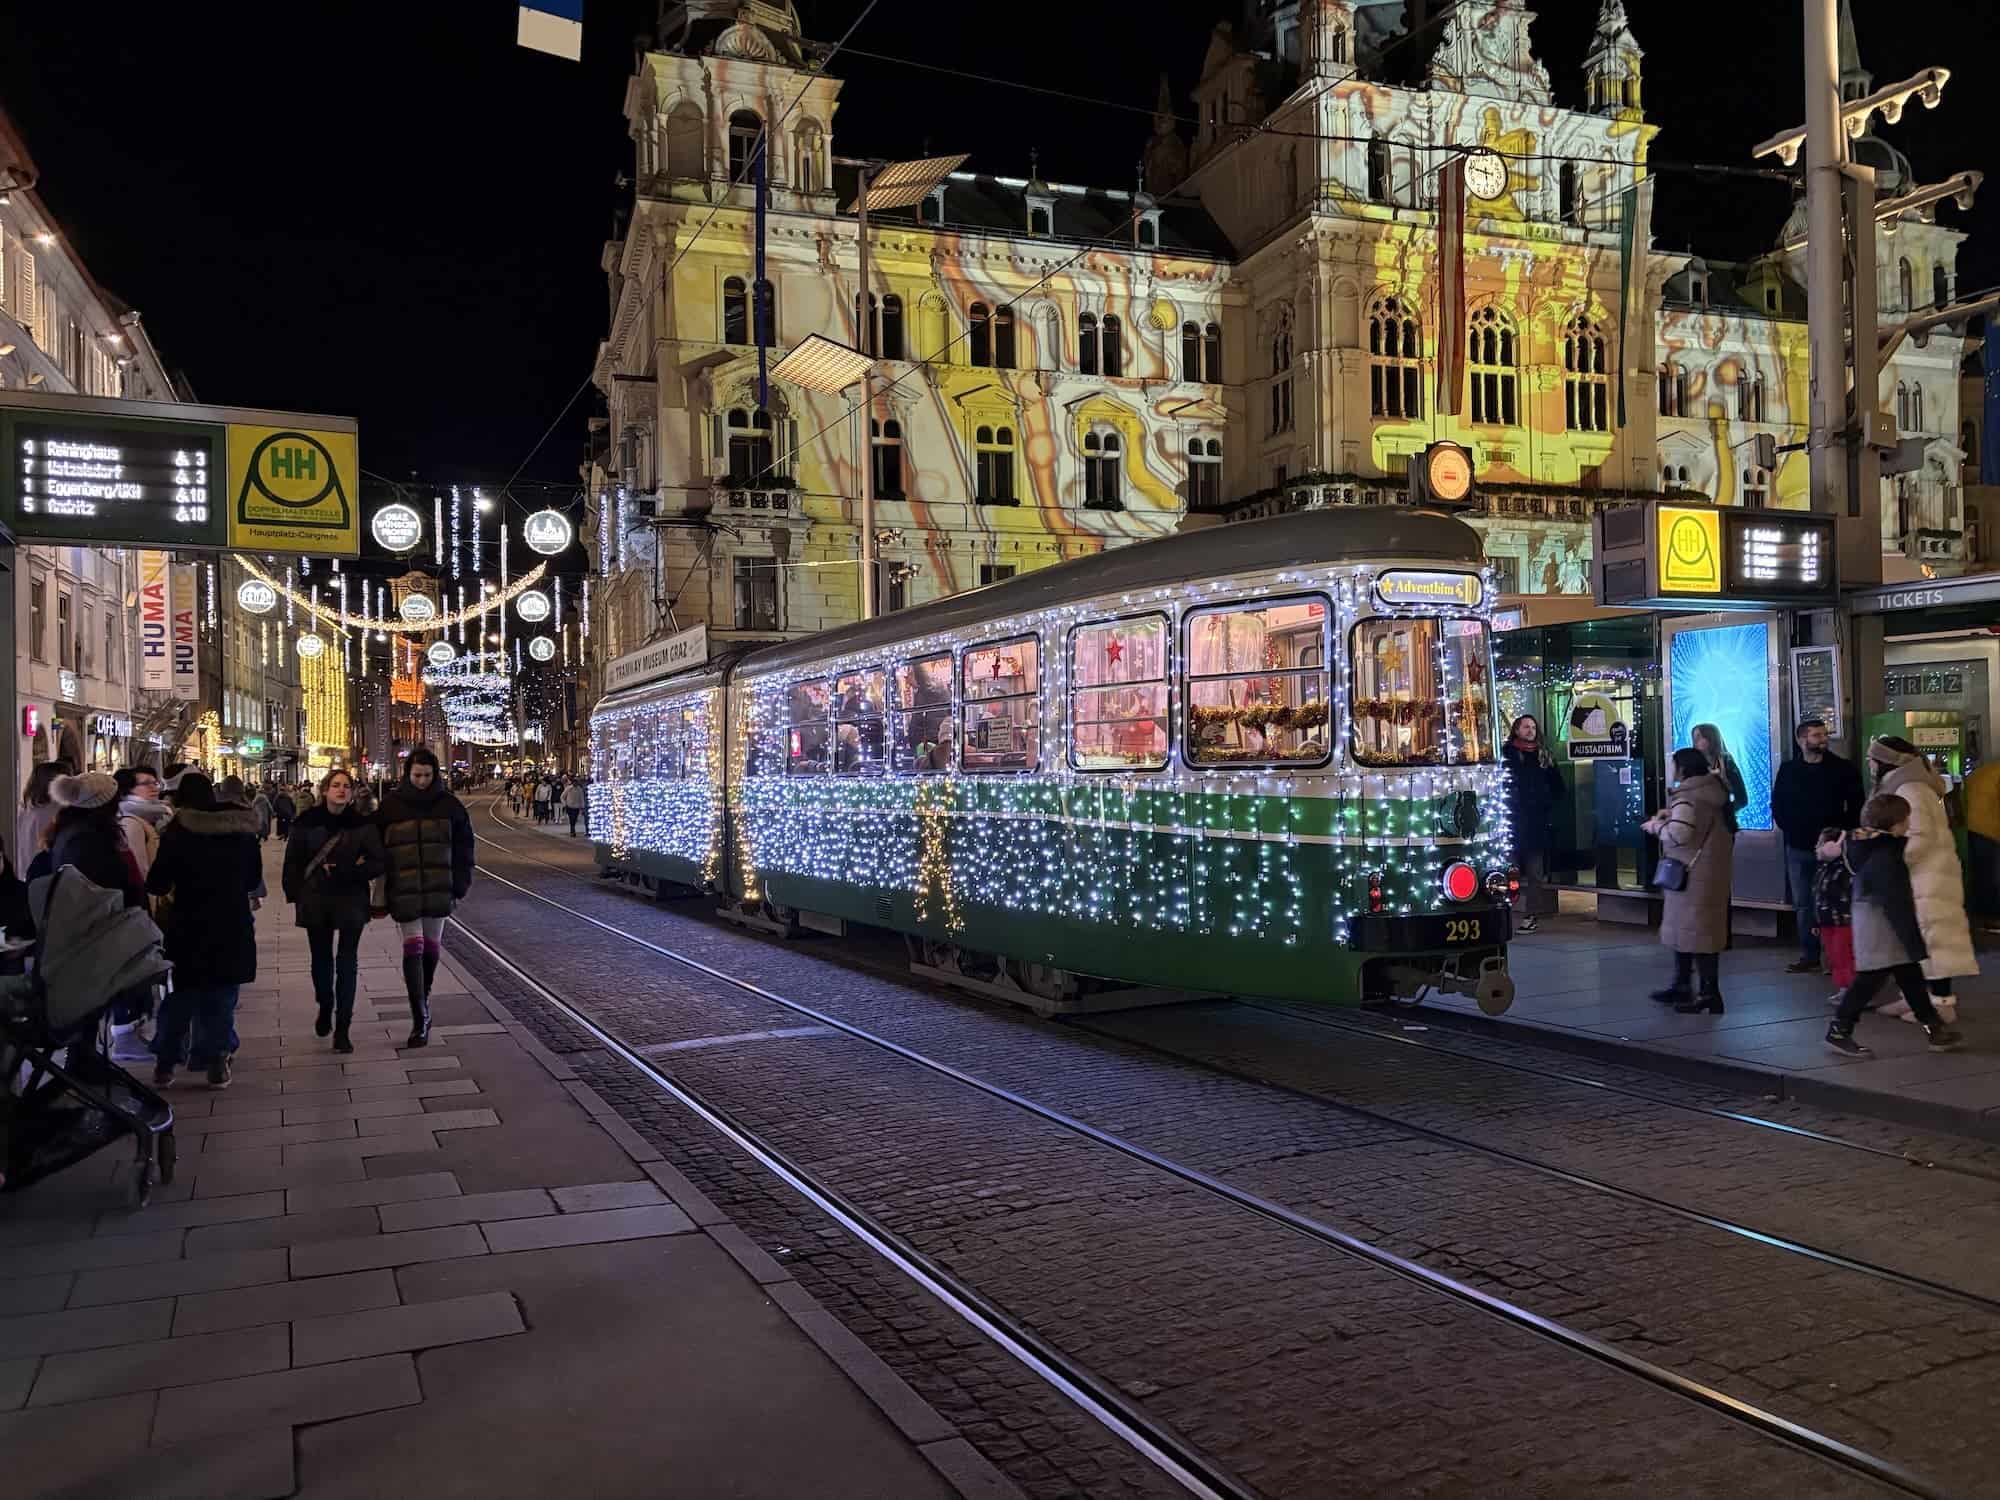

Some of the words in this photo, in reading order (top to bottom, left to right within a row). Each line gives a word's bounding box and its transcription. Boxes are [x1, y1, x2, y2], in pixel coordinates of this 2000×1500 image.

[23, 440, 34, 455] 4
[195, 451, 206, 467] 3
[271, 447, 317, 481] HH
[23, 459, 34, 474] 7
[195, 469, 206, 485] 3
[23, 478, 33, 493] 1
[190, 487, 207, 503] 10
[23, 496, 34, 512] 5
[47, 498, 96, 515] Andritz
[190, 506, 207, 522] 10
[1678, 529, 1700, 553] HH
[1396, 580, 1454, 595] Adventbim
[1878, 590, 1944, 609] TICKETS
[616, 658, 642, 680] TRAMWAY
[643, 648, 669, 670] MUSEUM
[670, 641, 688, 662] GRAZ
[97, 713, 114, 736] CAFÉ
[1446, 919, 1481, 942] 293
